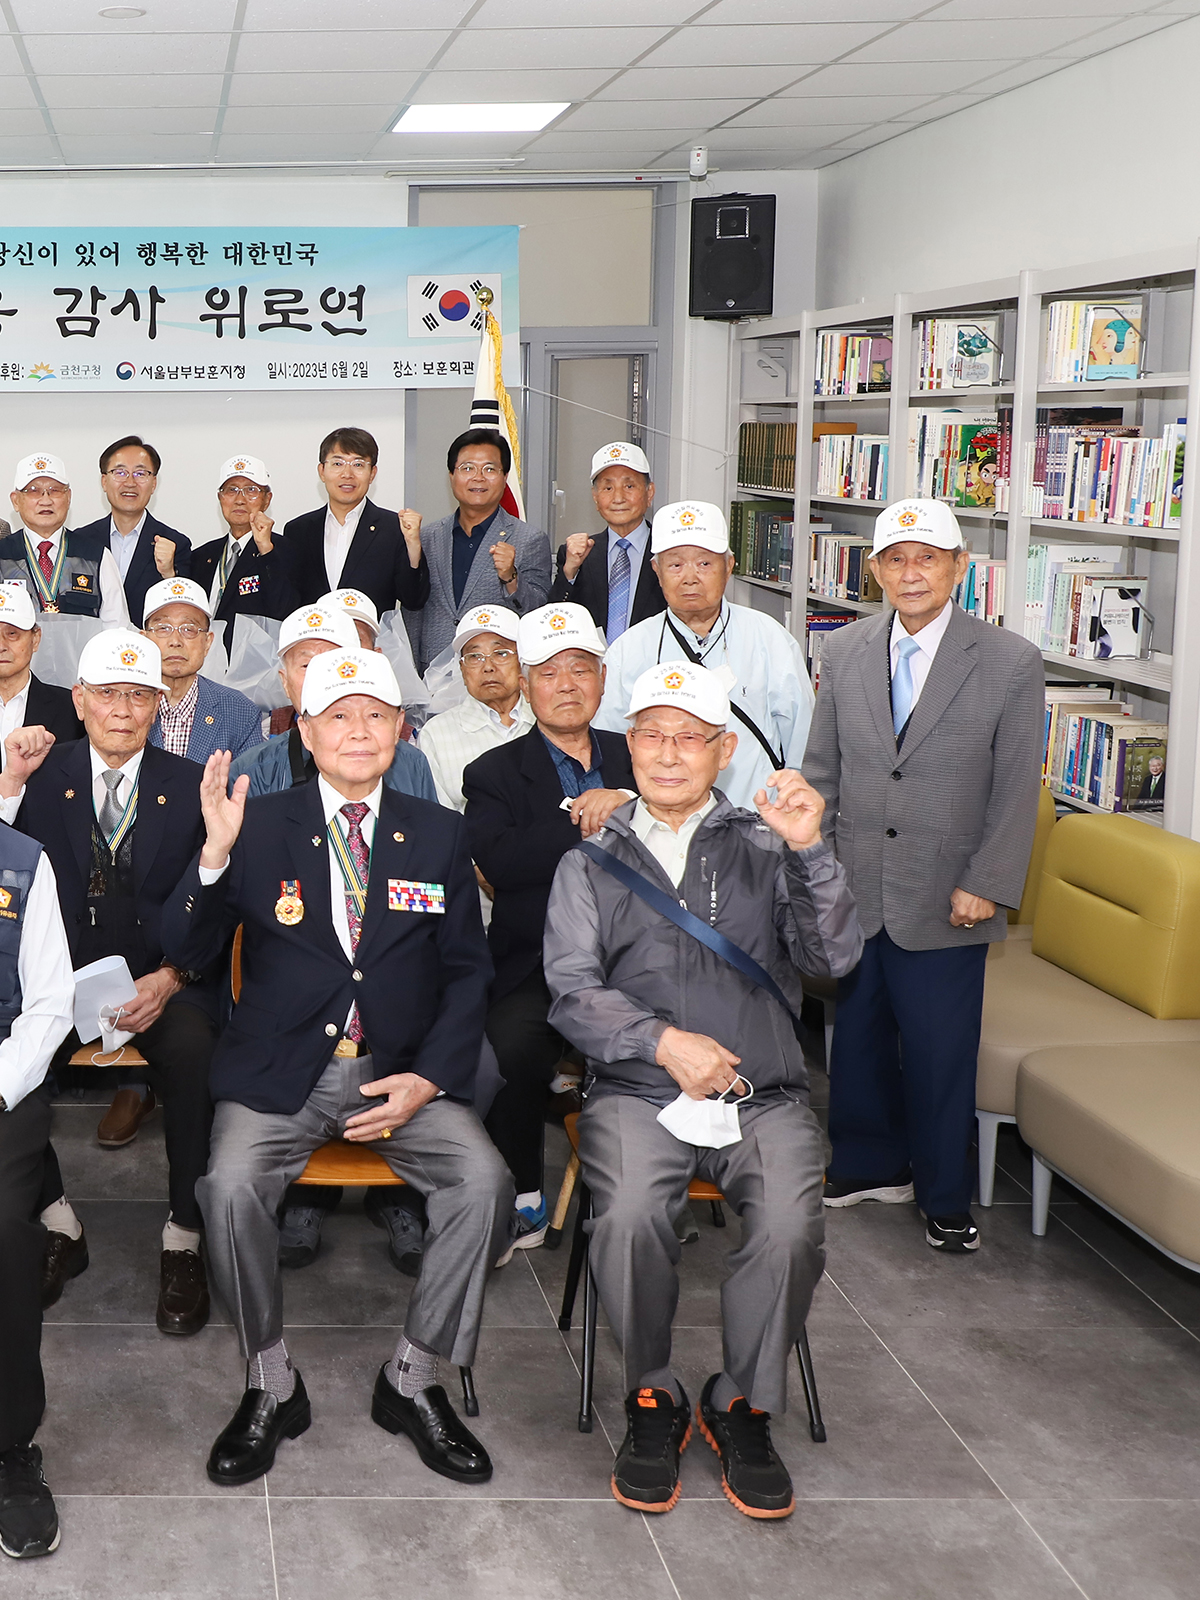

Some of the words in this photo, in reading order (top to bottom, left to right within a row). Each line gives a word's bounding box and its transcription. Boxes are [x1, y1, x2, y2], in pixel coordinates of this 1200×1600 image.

[74, 241, 120, 268] 있어
[136, 241, 209, 267] 행복한
[222, 240, 320, 267] 대한민국
[52, 284, 167, 340] 감사
[198, 284, 368, 340] 위로연
[0, 363, 25, 381] 후원:
[60, 364, 101, 376] 금천구청
[140, 364, 247, 381] 서울남부보훈지청
[267, 361, 329, 380] 일시:2023년
[331, 360, 349, 379] 6월
[352, 360, 369, 379] 2일
[393, 360, 418, 378] 장소:
[423, 361, 475, 376] 보훈회관
